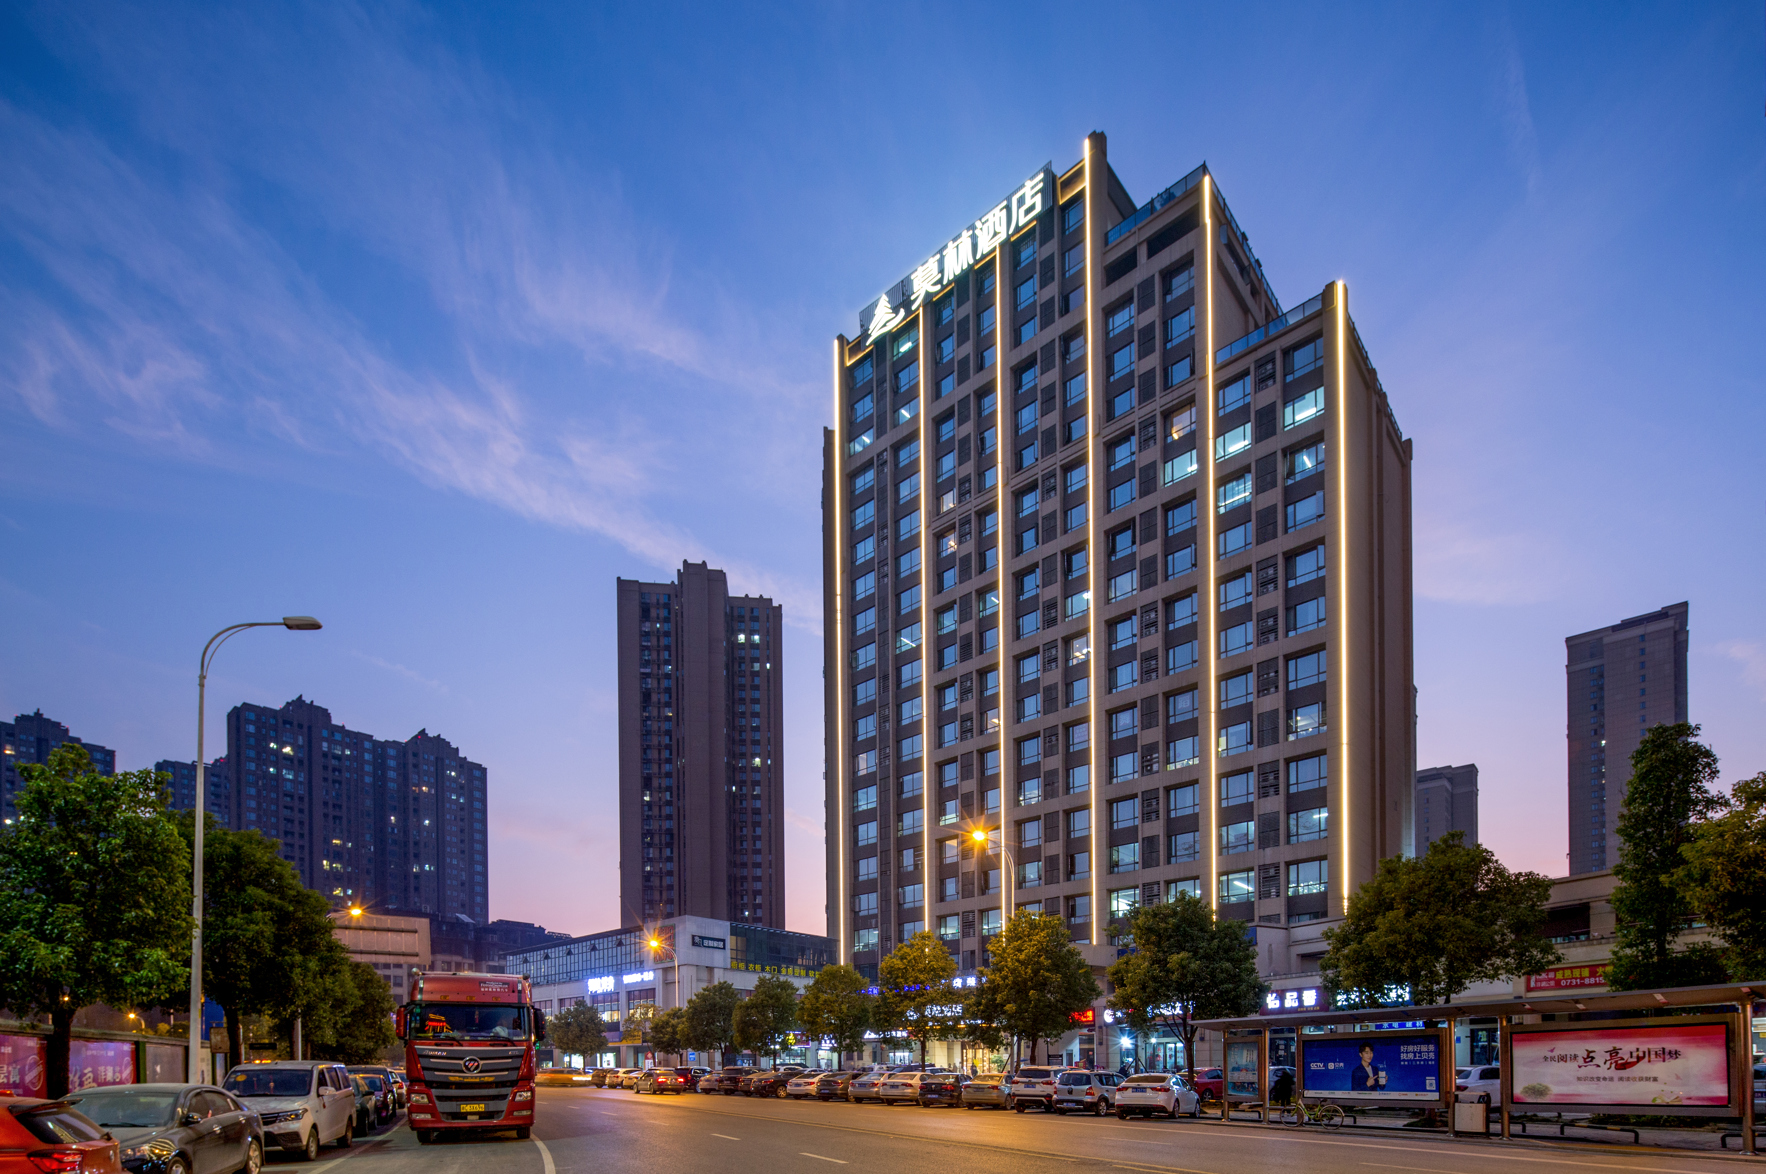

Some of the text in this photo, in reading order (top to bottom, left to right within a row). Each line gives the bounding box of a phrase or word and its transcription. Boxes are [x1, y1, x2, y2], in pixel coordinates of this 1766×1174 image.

[911, 172, 1044, 311] 莫林酒店
[765, 966, 777, 974] 木门
[1400, 1044, 1435, 1052] 好房好服务
[1400, 1052, 1435, 1060] 找房上贝壳
